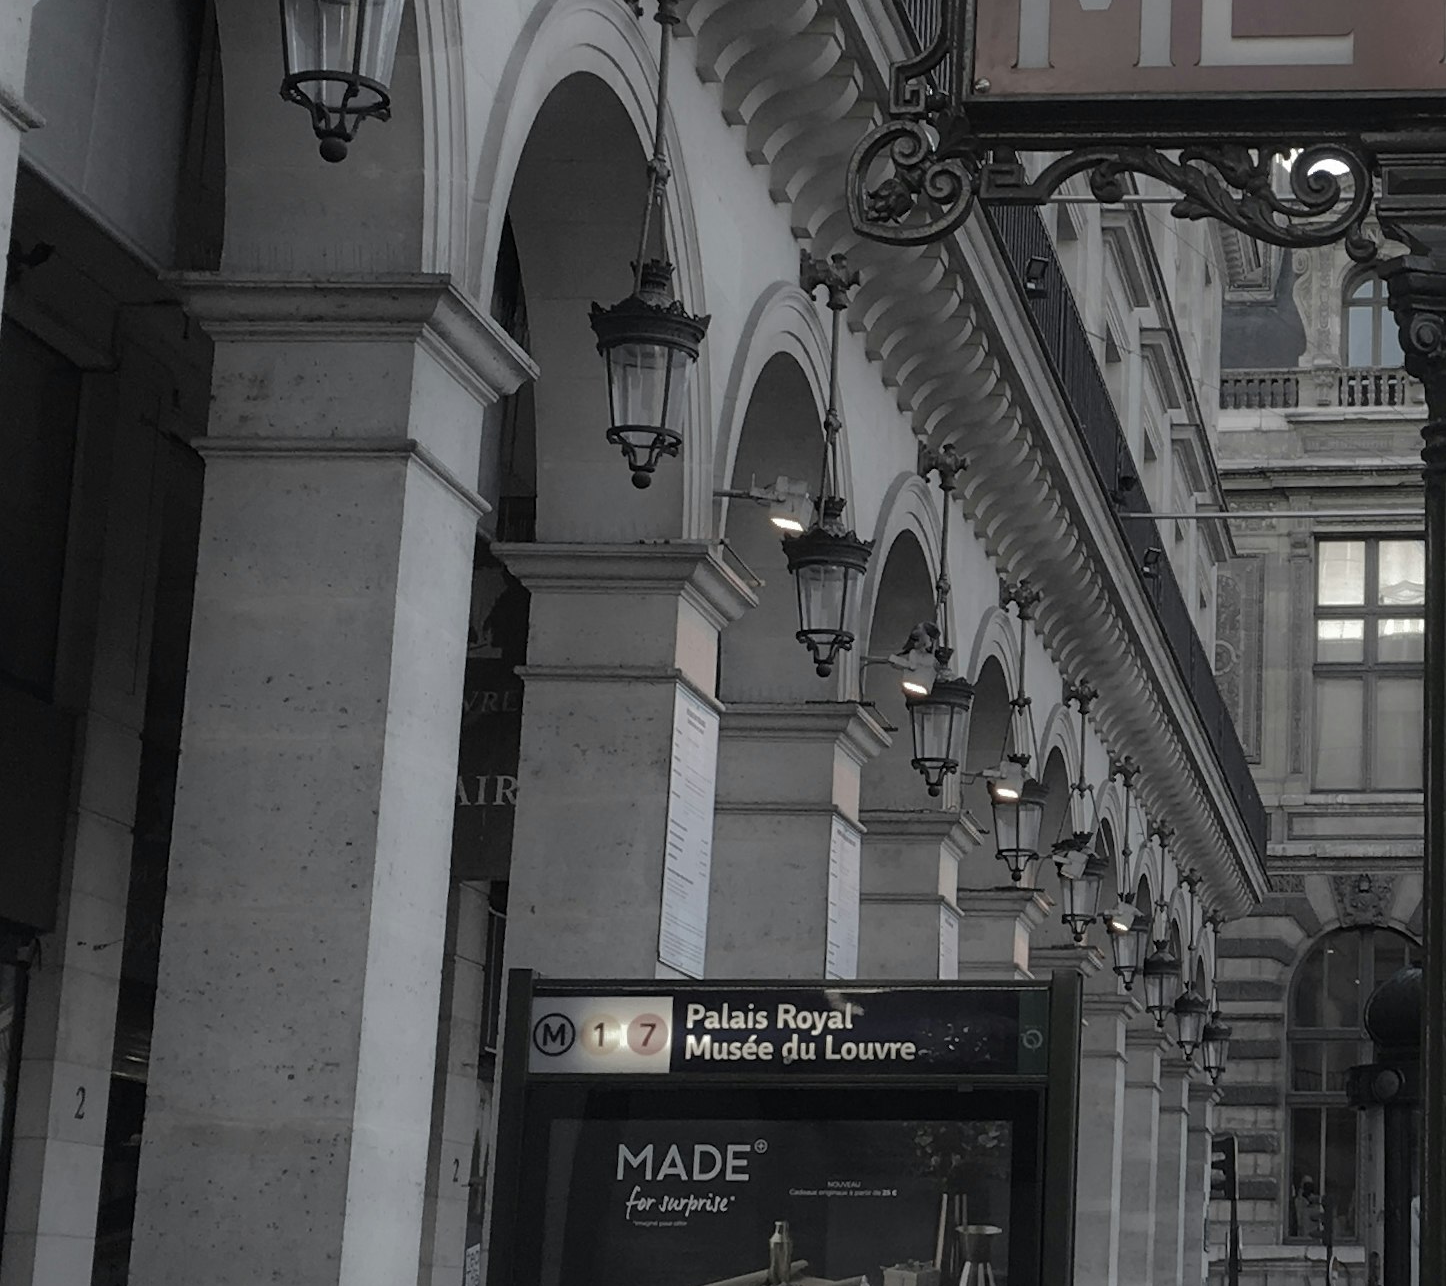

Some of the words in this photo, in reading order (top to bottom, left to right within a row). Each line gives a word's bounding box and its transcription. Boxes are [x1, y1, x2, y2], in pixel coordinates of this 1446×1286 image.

[541, 1022, 567, 1046] M
[593, 1023, 606, 1047] 1
[640, 1023, 656, 1048] 7
[685, 1002, 769, 1030] Palais
[776, 1003, 855, 1036] Royal
[684, 1033, 774, 1061] Musée
[781, 1035, 817, 1062] du
[825, 1035, 916, 1061] Louvre
[74, 1086, 87, 1120] 2
[451, 1158, 460, 1183] 2
[616, 1143, 751, 1182] MADE
[625, 1185, 654, 1220] for
